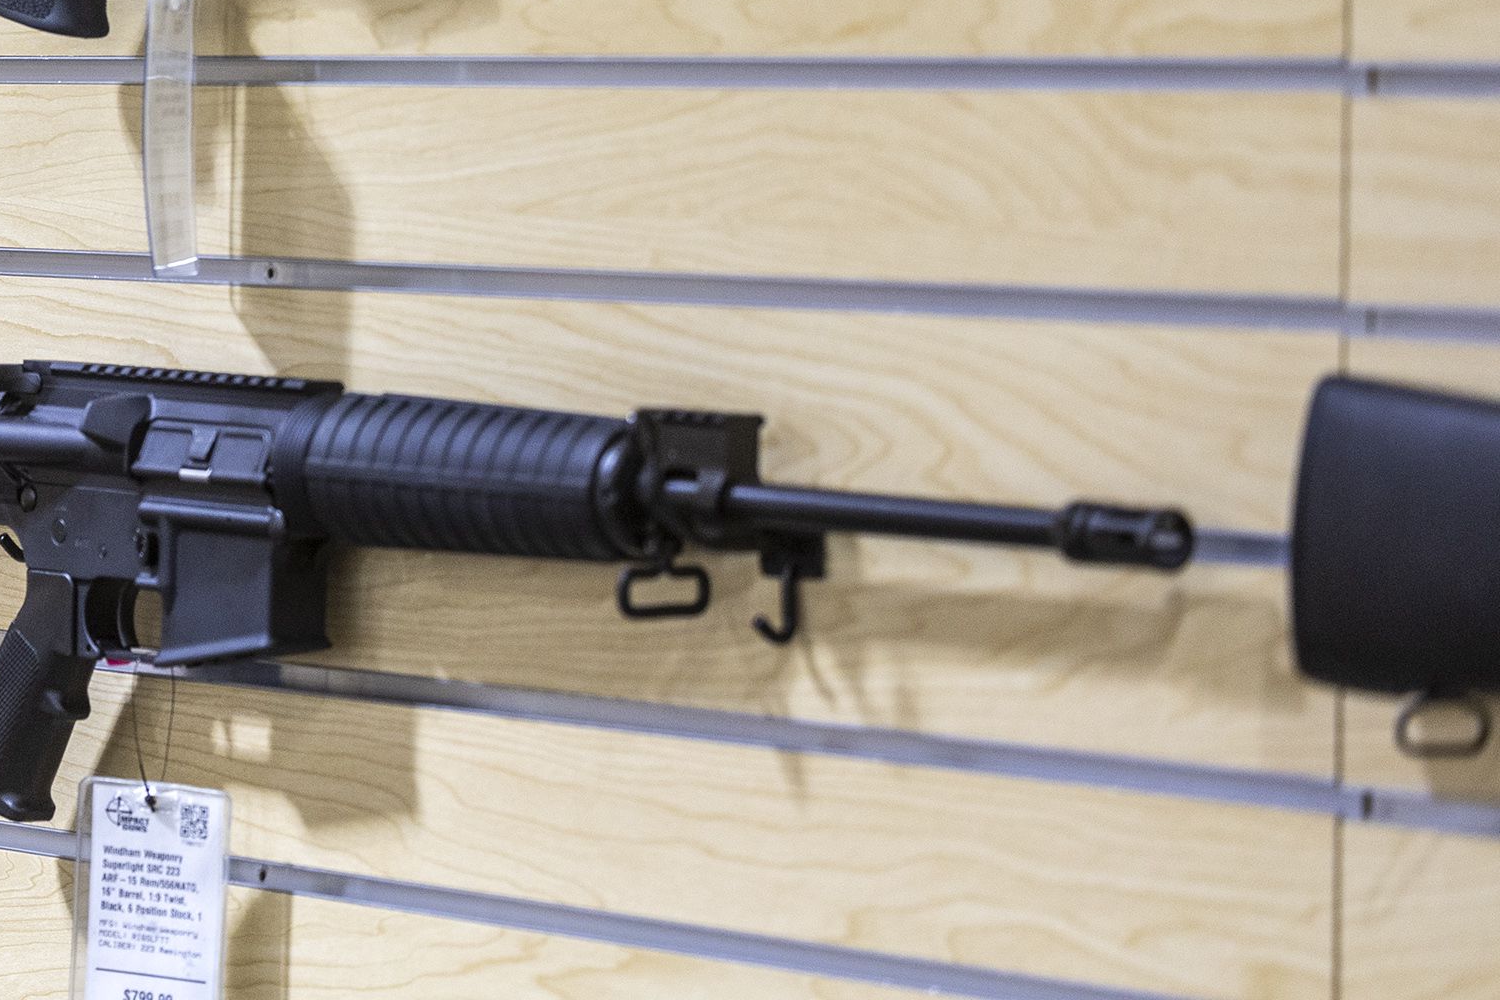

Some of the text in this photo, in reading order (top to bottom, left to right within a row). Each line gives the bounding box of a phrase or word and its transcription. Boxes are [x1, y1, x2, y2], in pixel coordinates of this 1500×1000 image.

[103, 845, 183, 864] Windham Weaponry
[102, 859, 181, 877] Superlight SRC 223
[101, 873, 118, 883] ARF
[128, 876, 137, 886] 15
[119, 889, 145, 901] Barrel,
[149, 892, 162, 903] 1:9
[100, 900, 125, 913] Black,
[128, 903, 133, 913] 6
[135, 904, 168, 917] Position
[170, 908, 195, 921] Stock,
